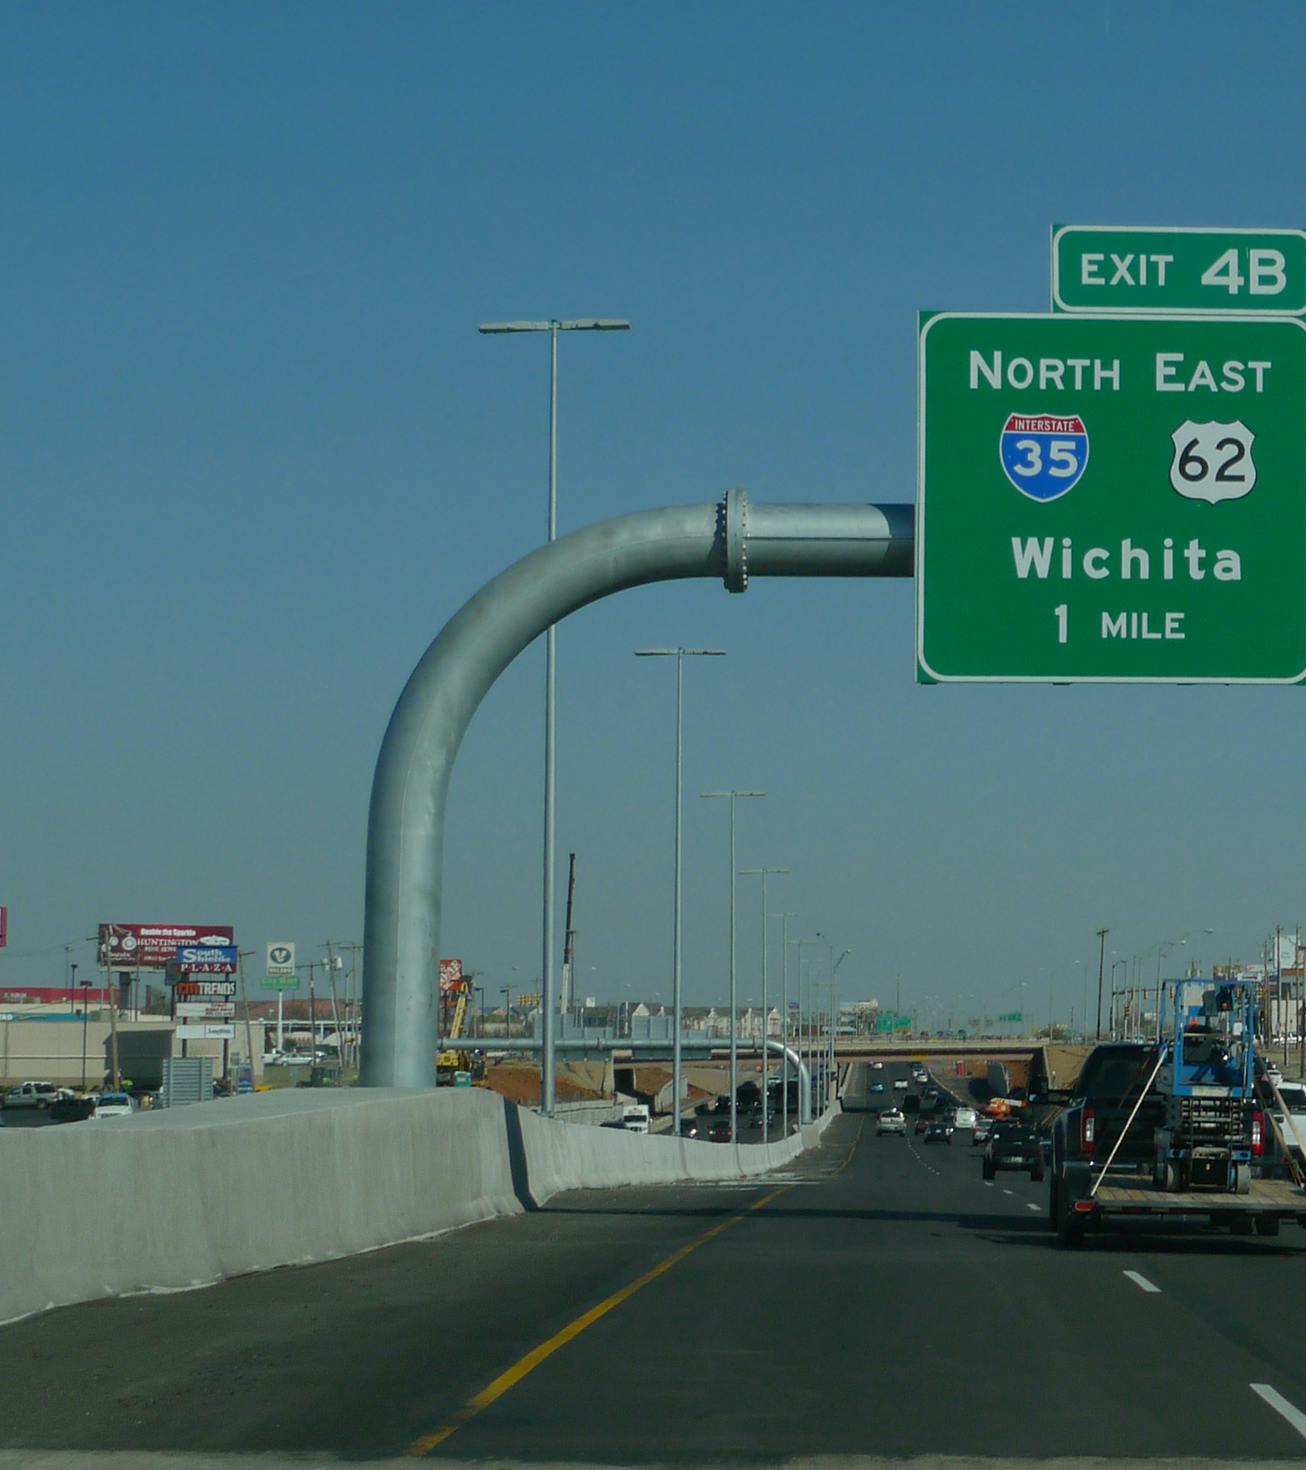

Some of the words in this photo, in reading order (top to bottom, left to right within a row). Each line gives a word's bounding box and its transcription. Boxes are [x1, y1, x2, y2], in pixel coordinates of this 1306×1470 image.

[1081, 254, 1173, 286] EXIT
[1201, 249, 1287, 295] 4B
[969, 350, 1120, 391] NORTH
[1156, 352, 1271, 393] EAST
[1014, 419, 1075, 433] INTERSTATE
[1013, 440, 1079, 478] 35
[1178, 437, 1246, 483] 62
[1012, 537, 1242, 581] Wichita
[1055, 604, 1069, 643] 1
[1101, 611, 1185, 640] MILE
